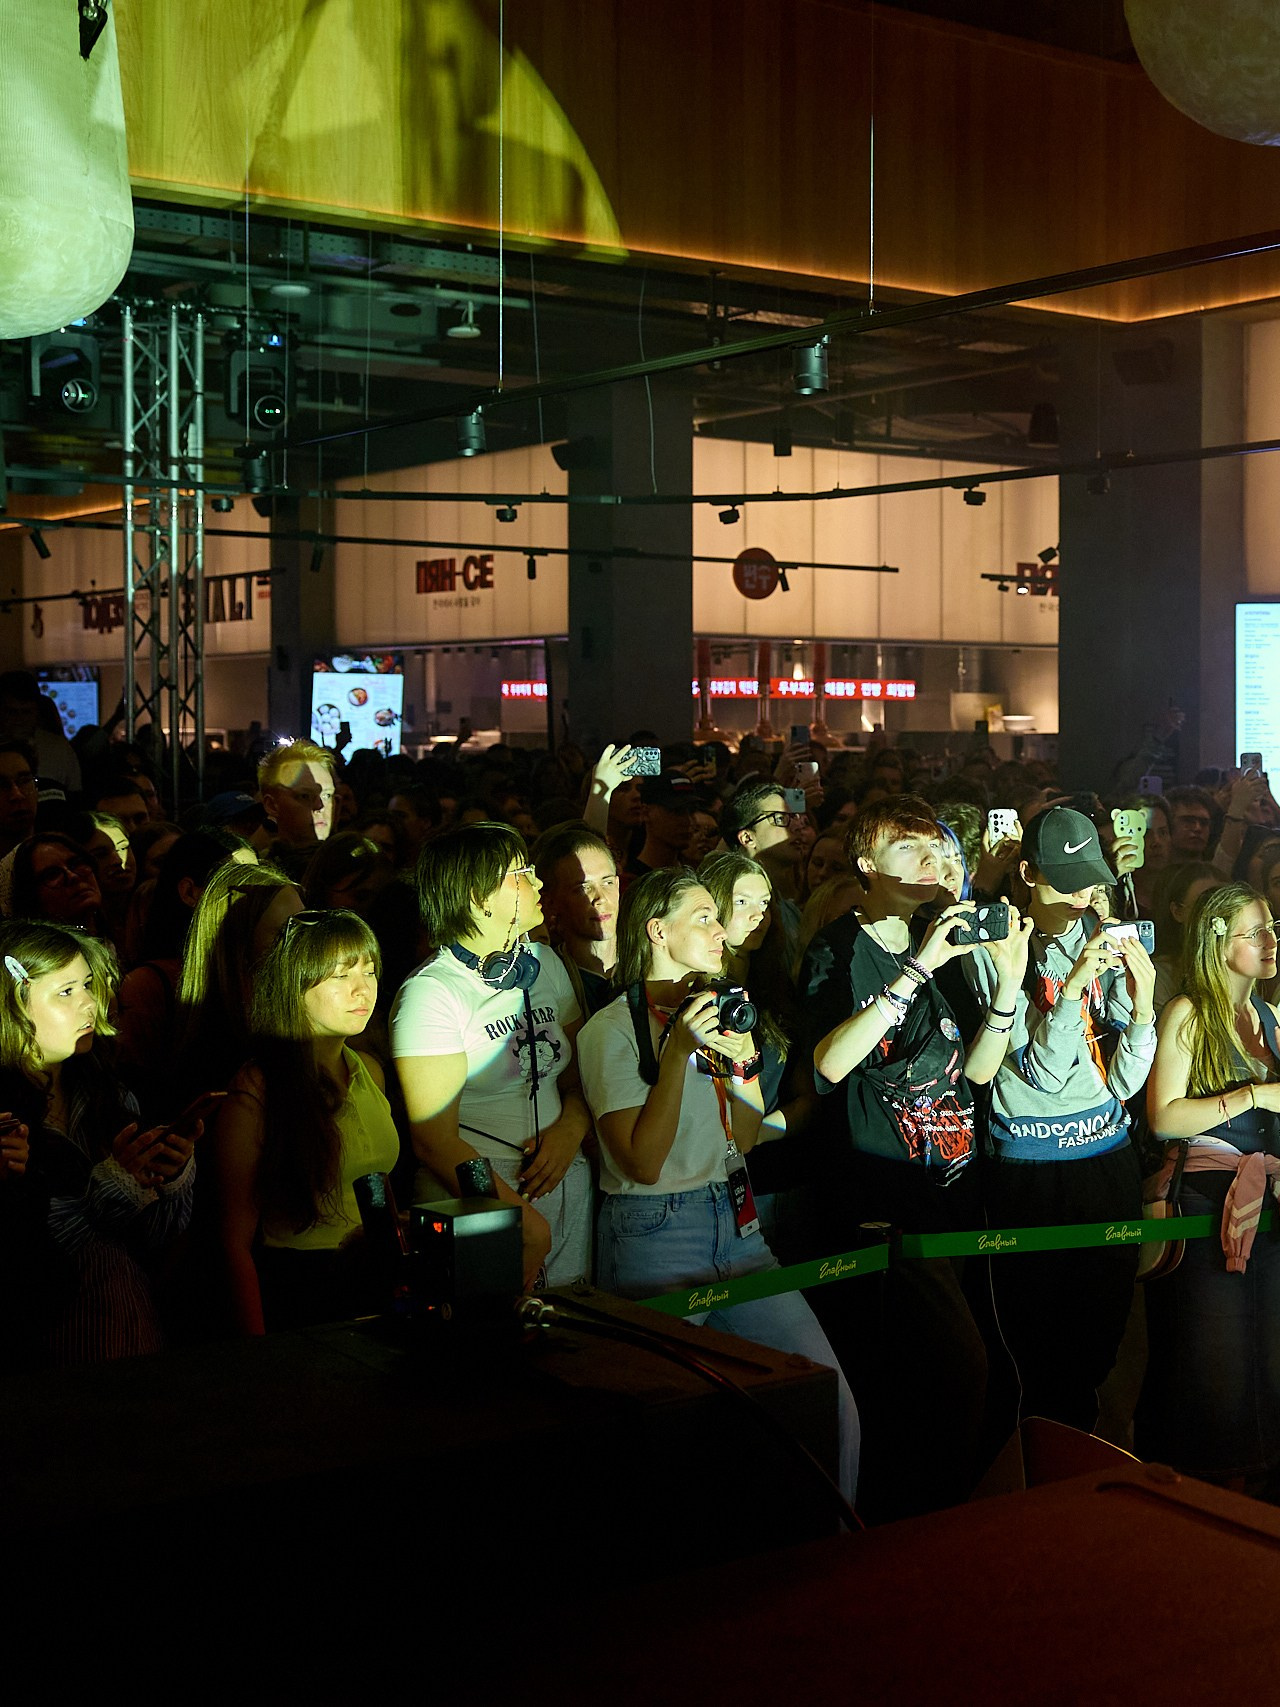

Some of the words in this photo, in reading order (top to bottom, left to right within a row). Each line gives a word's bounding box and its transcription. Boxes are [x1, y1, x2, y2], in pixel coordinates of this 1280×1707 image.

[484, 1013, 524, 1041] ROCK
[978, 1233, 1017, 1250] Главный
[1105, 1225, 1142, 1241] Главный
[819, 1259, 857, 1279] Главный
[688, 1288, 729, 1310] Главный
